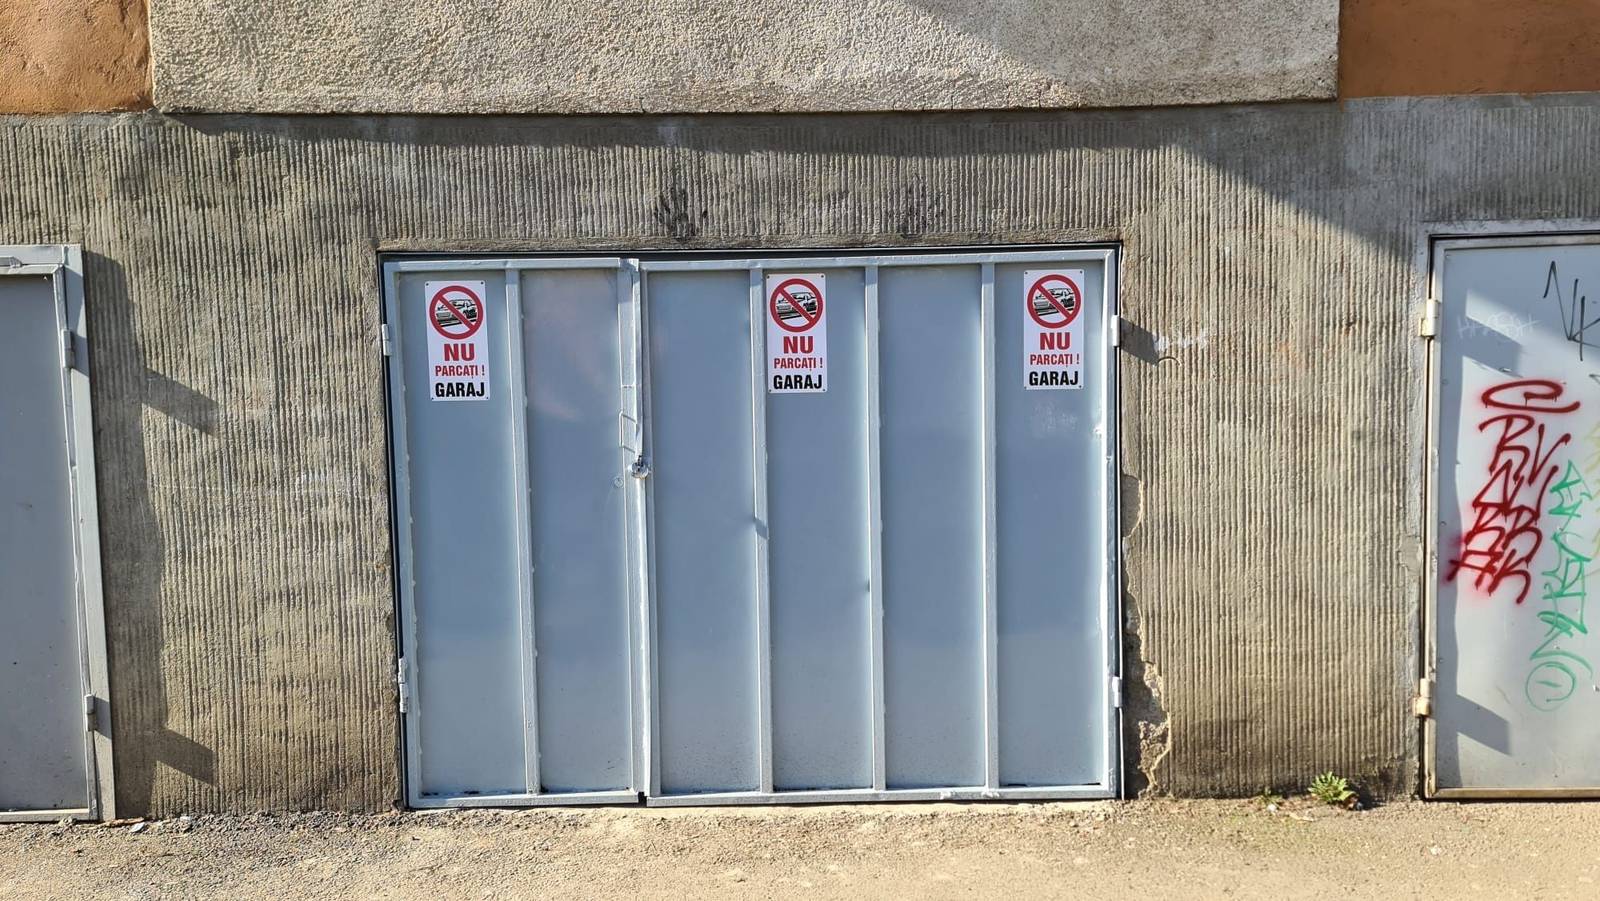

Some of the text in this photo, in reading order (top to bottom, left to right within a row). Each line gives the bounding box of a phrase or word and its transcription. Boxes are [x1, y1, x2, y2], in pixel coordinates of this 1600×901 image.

[783, 336, 814, 354] NU
[1039, 332, 1071, 351] NU
[443, 343, 475, 362] NU
[773, 374, 823, 390] GARAJ
[1029, 370, 1079, 386] GARAJ
[435, 382, 485, 398] GARAJ
